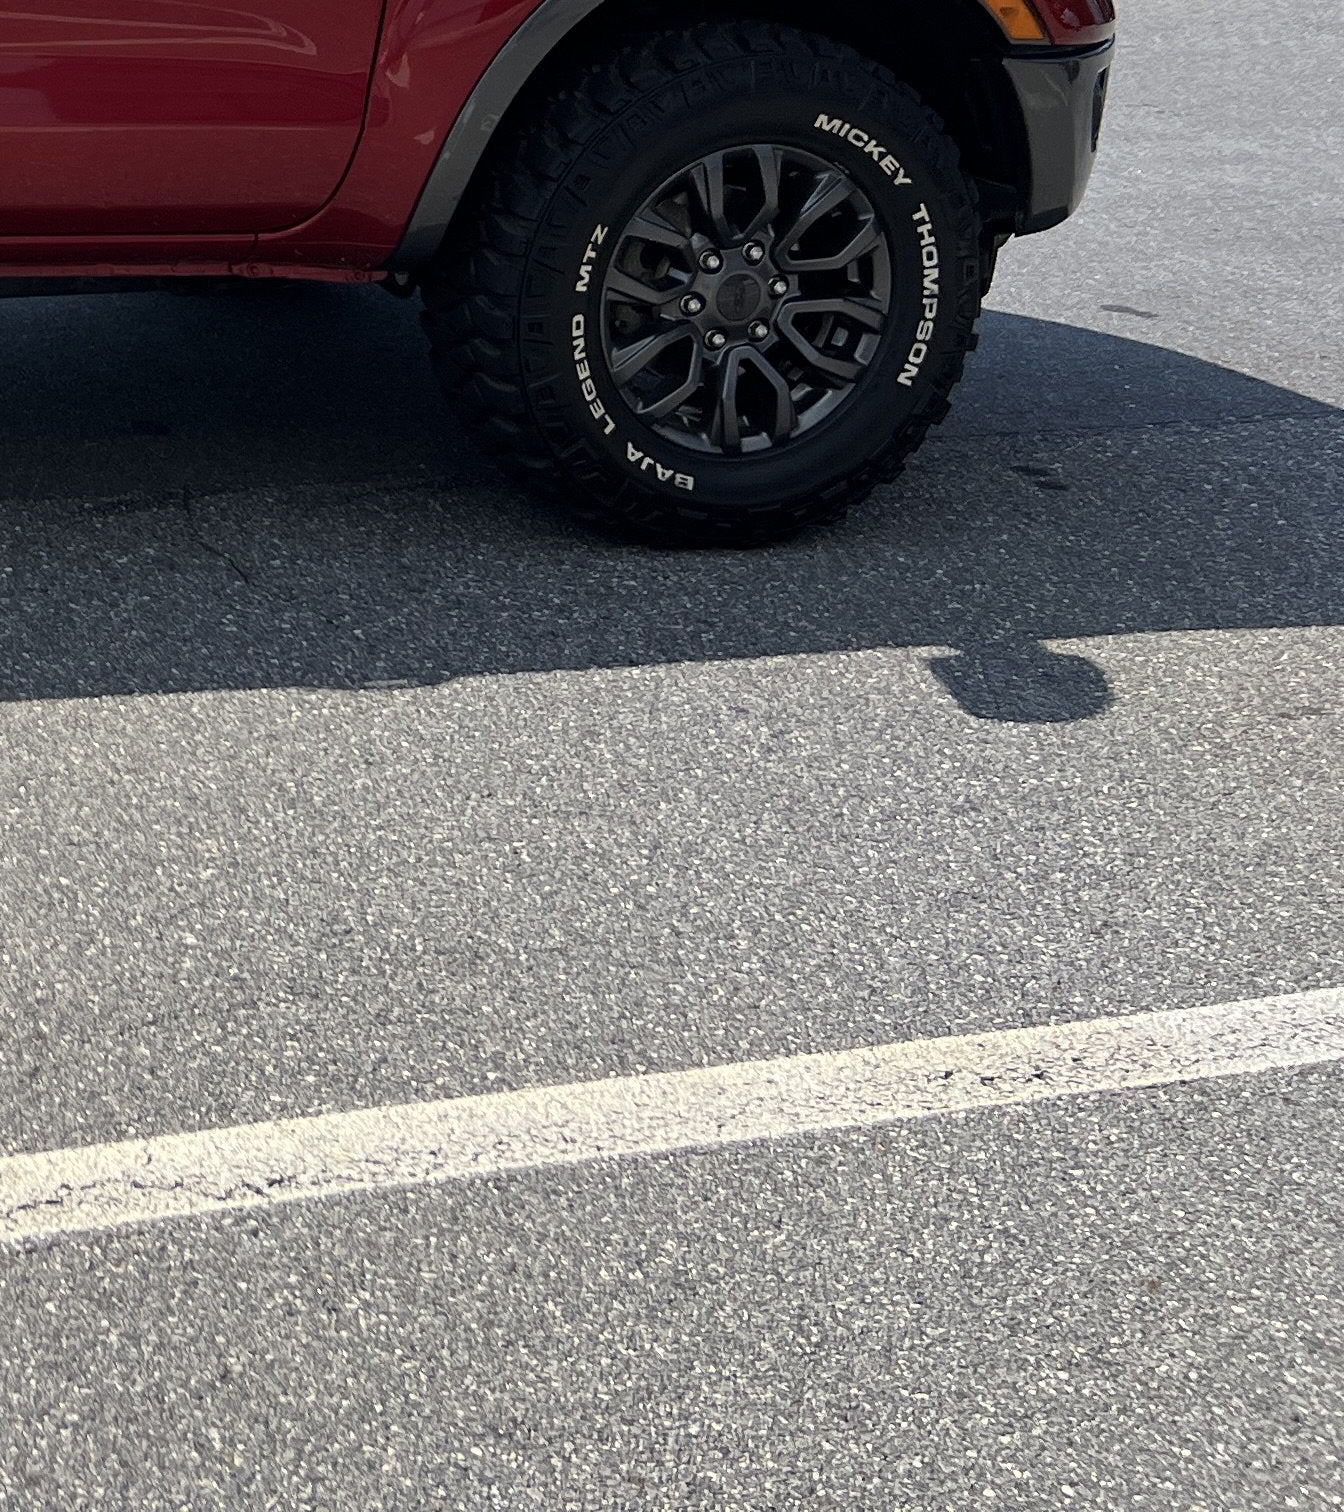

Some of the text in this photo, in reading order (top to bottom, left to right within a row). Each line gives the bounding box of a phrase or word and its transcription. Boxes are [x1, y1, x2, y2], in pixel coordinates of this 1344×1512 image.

[571, 223, 695, 491] BAJA LEGEND MTZ
[813, 113, 939, 386] MICKEY THOMPSON
